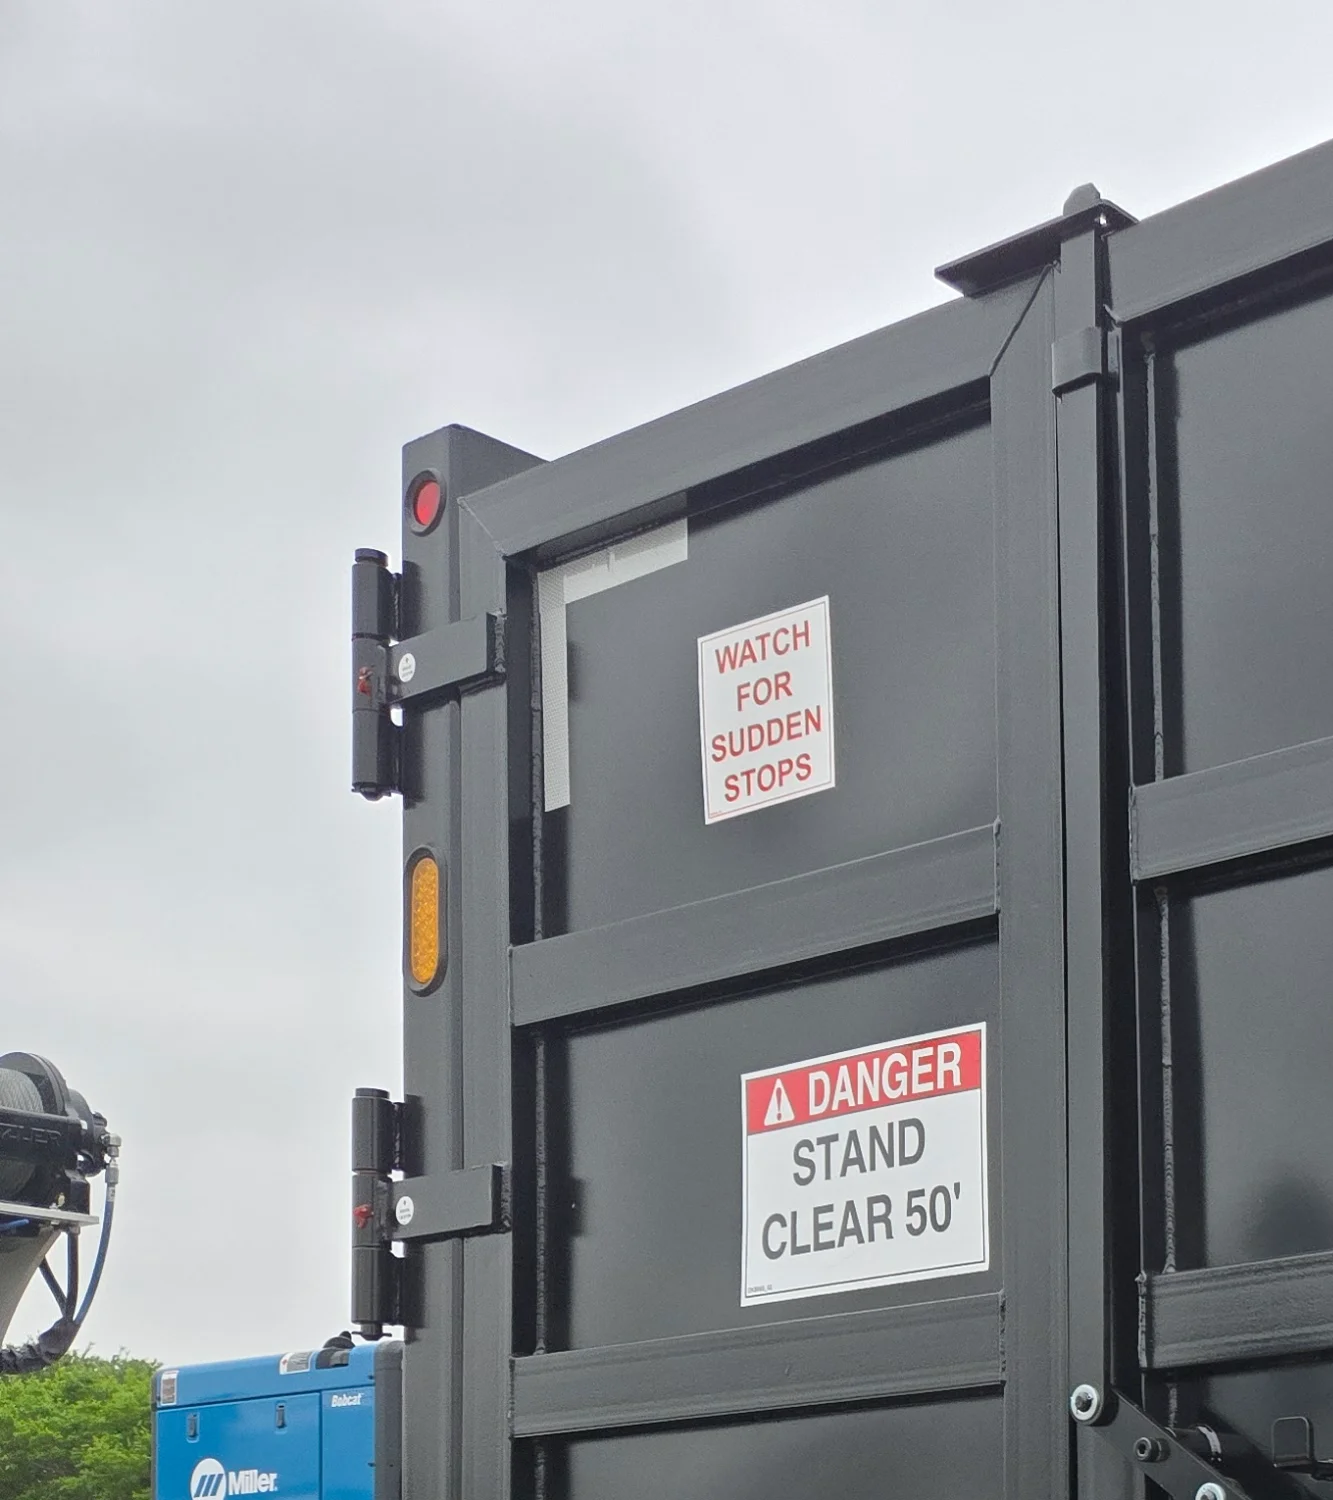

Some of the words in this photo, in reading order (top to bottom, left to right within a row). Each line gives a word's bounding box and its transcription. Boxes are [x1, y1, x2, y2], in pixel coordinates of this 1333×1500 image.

[715, 620, 810, 674] WATCH
[737, 671, 793, 712] FOR
[711, 705, 821, 762] SUDDEN
[724, 753, 811, 802] STOPS
[809, 1042, 961, 1116] DANGER
[793, 1118, 925, 1186] STAND
[762, 1194, 893, 1260] CLEAR
[906, 1182, 961, 1236] 50'
[332, 1392, 361, 1408] Bobcat
[228, 1469, 277, 1496] Miller
